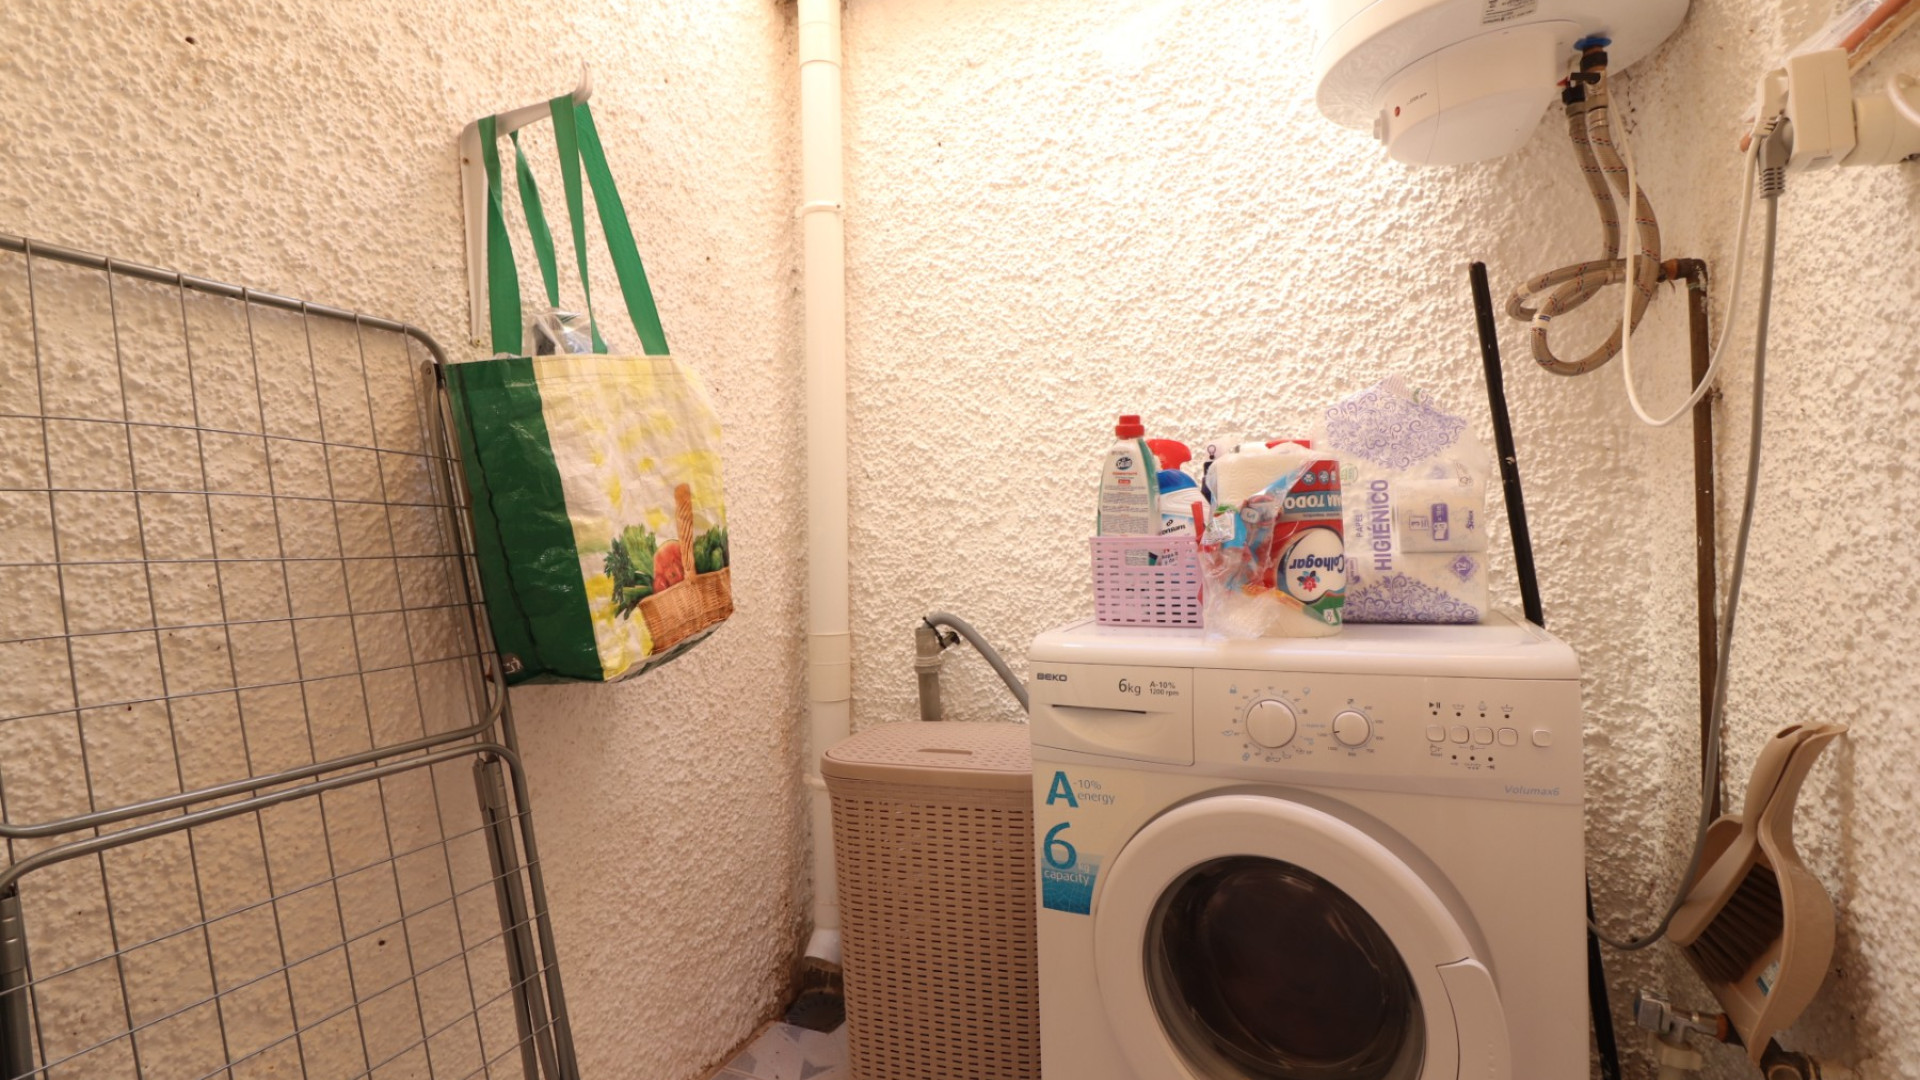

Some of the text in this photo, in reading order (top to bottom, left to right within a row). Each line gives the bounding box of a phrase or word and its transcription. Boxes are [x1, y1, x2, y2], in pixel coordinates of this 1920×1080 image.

[1284, 493, 1325, 510] TODO
[1355, 513, 1364, 539] PAPEL
[1366, 479, 1393, 571] HIGIÉNICO
[1289, 554, 1345, 573] Colhogar
[1037, 672, 1068, 682] BEKO
[1149, 680, 1176, 690] A-10%
[1118, 678, 1142, 696] 6kg
[1149, 688, 1180, 697] 1200 rpm
[1045, 770, 1079, 808] A
[1504, 784, 1561, 797] Volumax6
[1078, 791, 1116, 805] energy
[1043, 821, 1077, 870] 6
[1043, 869, 1090, 886] capacity
